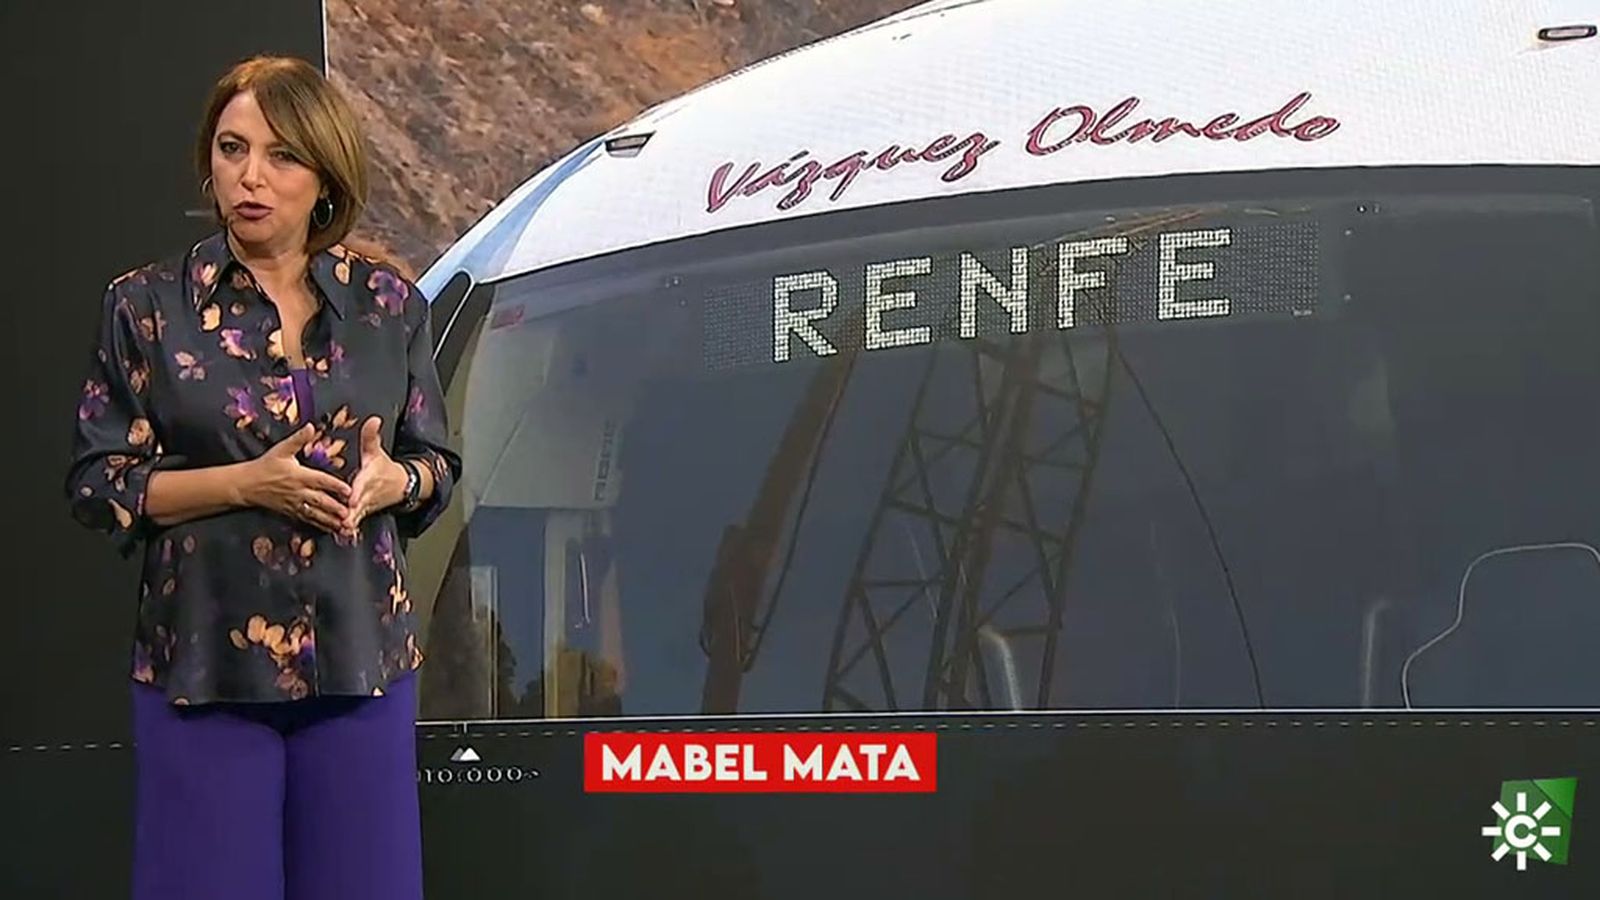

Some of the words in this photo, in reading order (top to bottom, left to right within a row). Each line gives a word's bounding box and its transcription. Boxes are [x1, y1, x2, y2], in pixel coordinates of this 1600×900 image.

[706, 131, 1000, 213] Vázquez
[1025, 91, 1340, 156] Olmedo
[772, 228, 1233, 362] RENFE
